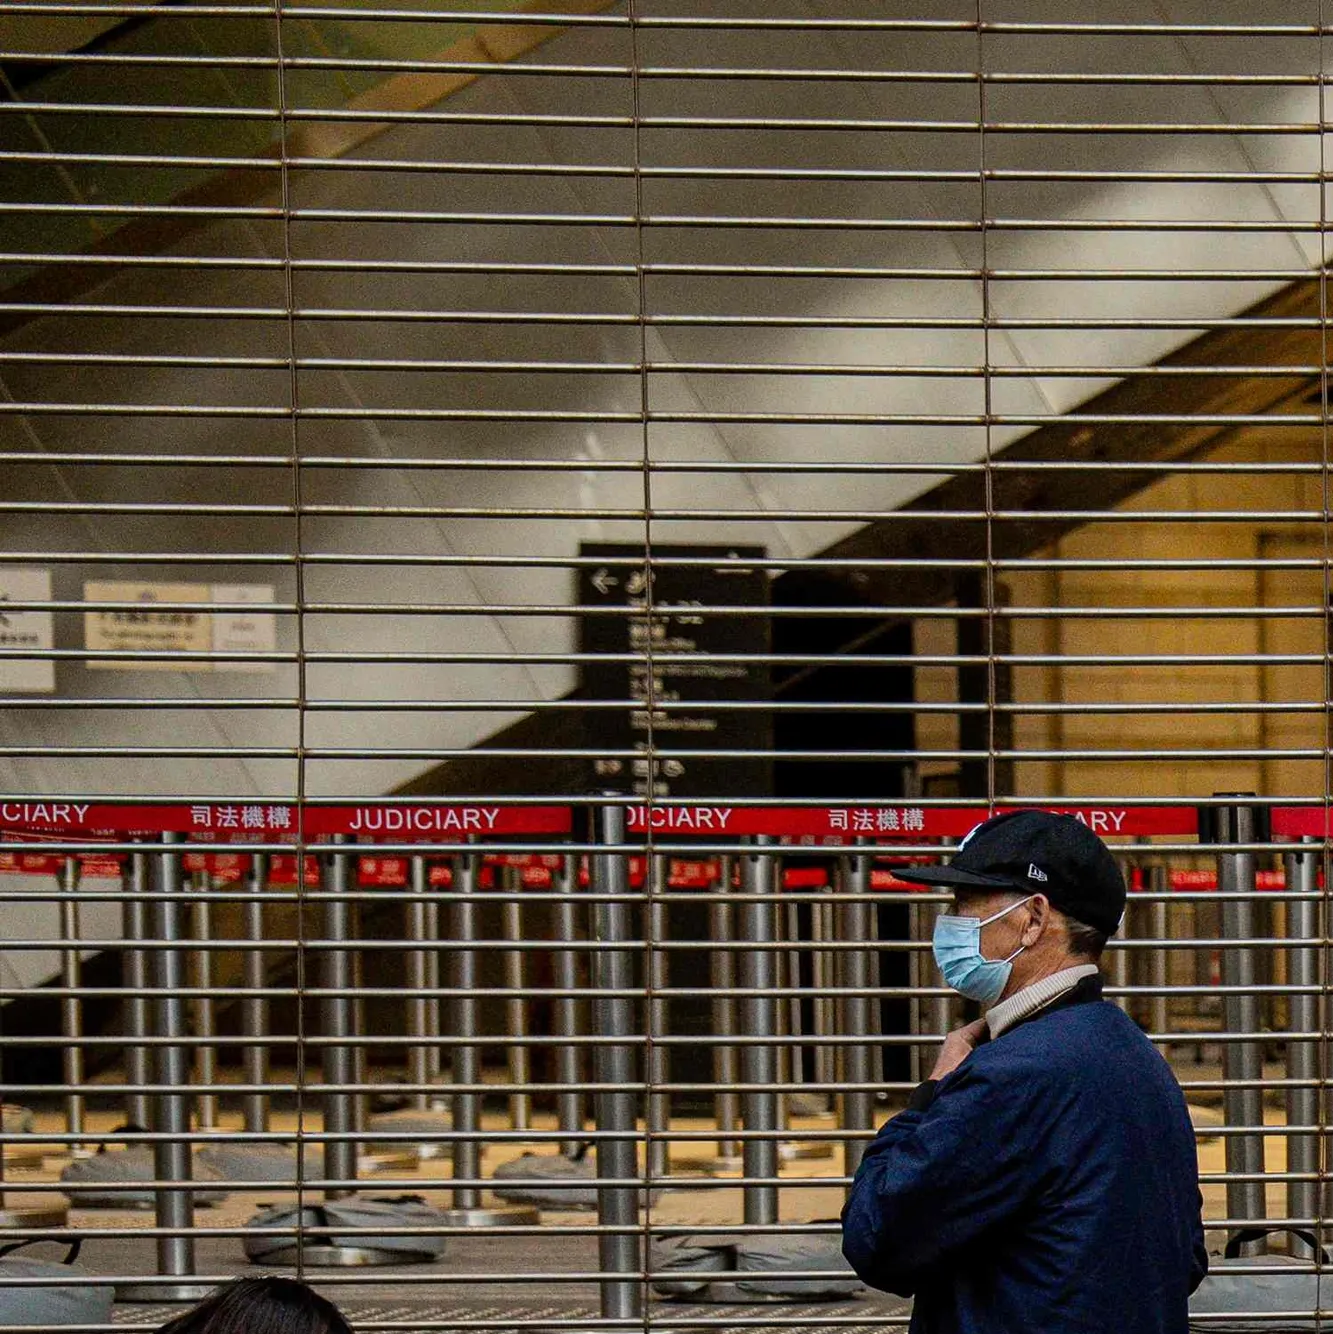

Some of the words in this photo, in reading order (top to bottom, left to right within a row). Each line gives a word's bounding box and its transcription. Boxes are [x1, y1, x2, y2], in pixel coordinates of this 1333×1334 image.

[190, 805, 292, 829] 司法機構
[349, 808, 499, 830] JUDICIARY
[828, 808, 925, 831] 司法機構
